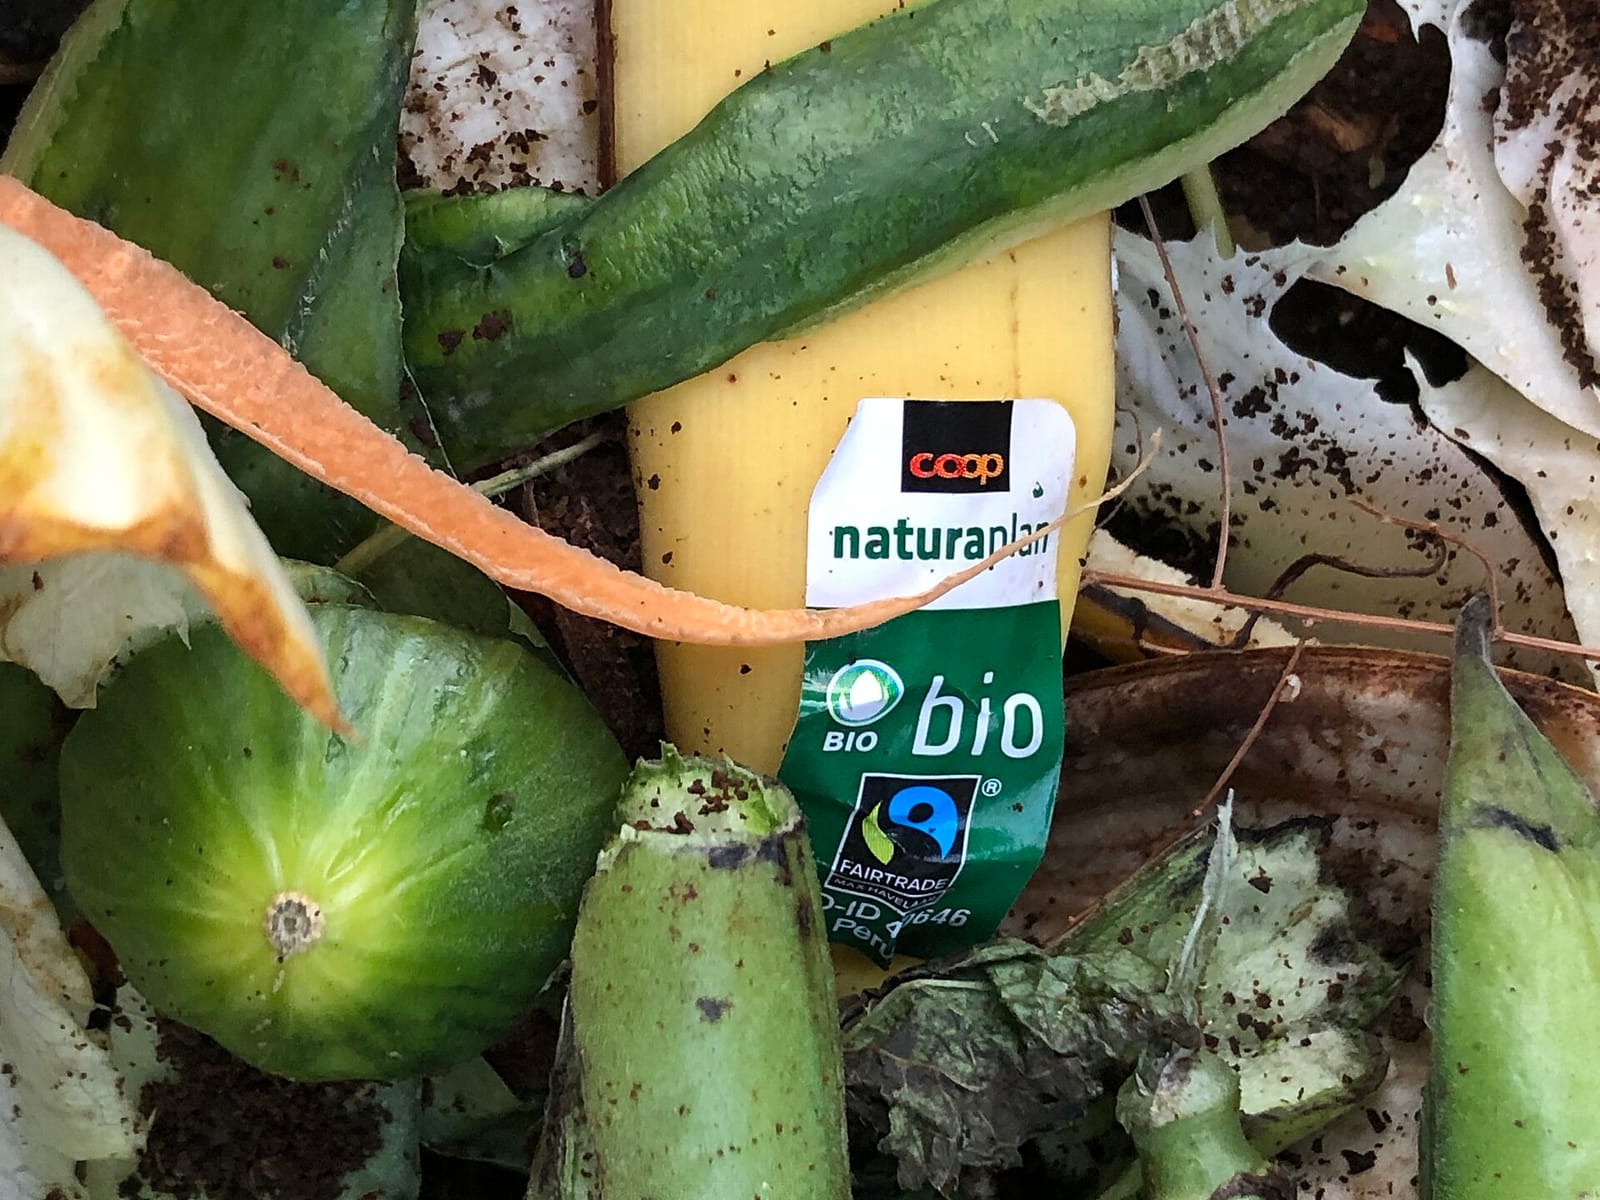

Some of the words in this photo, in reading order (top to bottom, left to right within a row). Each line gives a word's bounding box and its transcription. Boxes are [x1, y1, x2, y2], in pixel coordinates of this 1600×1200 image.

[909, 452, 1004, 485] coop
[833, 512, 1049, 571] naturaplan
[911, 671, 1043, 758] bio
[822, 731, 878, 752] BIO
[840, 859, 949, 891] FAIRTRADE
[832, 917, 896, 959] Peru
